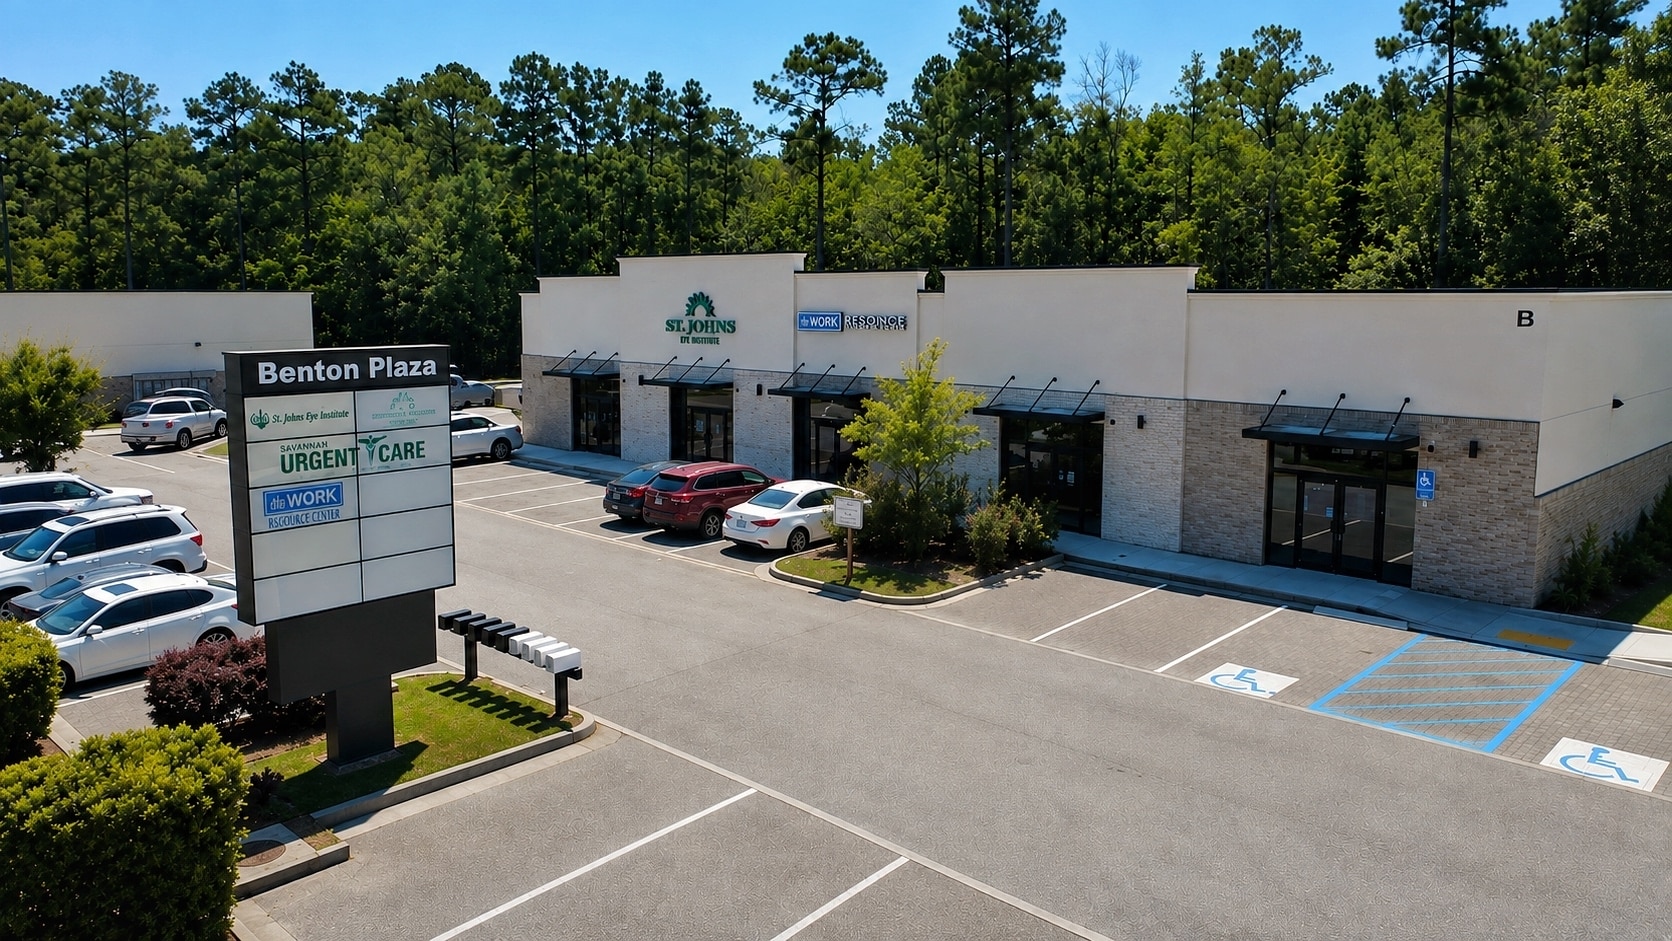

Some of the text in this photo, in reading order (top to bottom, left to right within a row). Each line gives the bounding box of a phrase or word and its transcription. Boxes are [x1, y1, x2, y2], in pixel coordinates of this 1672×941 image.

[665, 319, 736, 335] ST. JOHNS
[809, 315, 838, 327] WORK
[1516, 309, 1535, 328] B
[257, 356, 437, 385] Benton Plaza
[272, 414, 282, 423] St.
[283, 412, 304, 425] Johns
[306, 412, 319, 423] Eye
[280, 441, 328, 453] SAVANNAH
[280, 440, 426, 474] URGENT CARE
[286, 487, 337, 508] WORK
